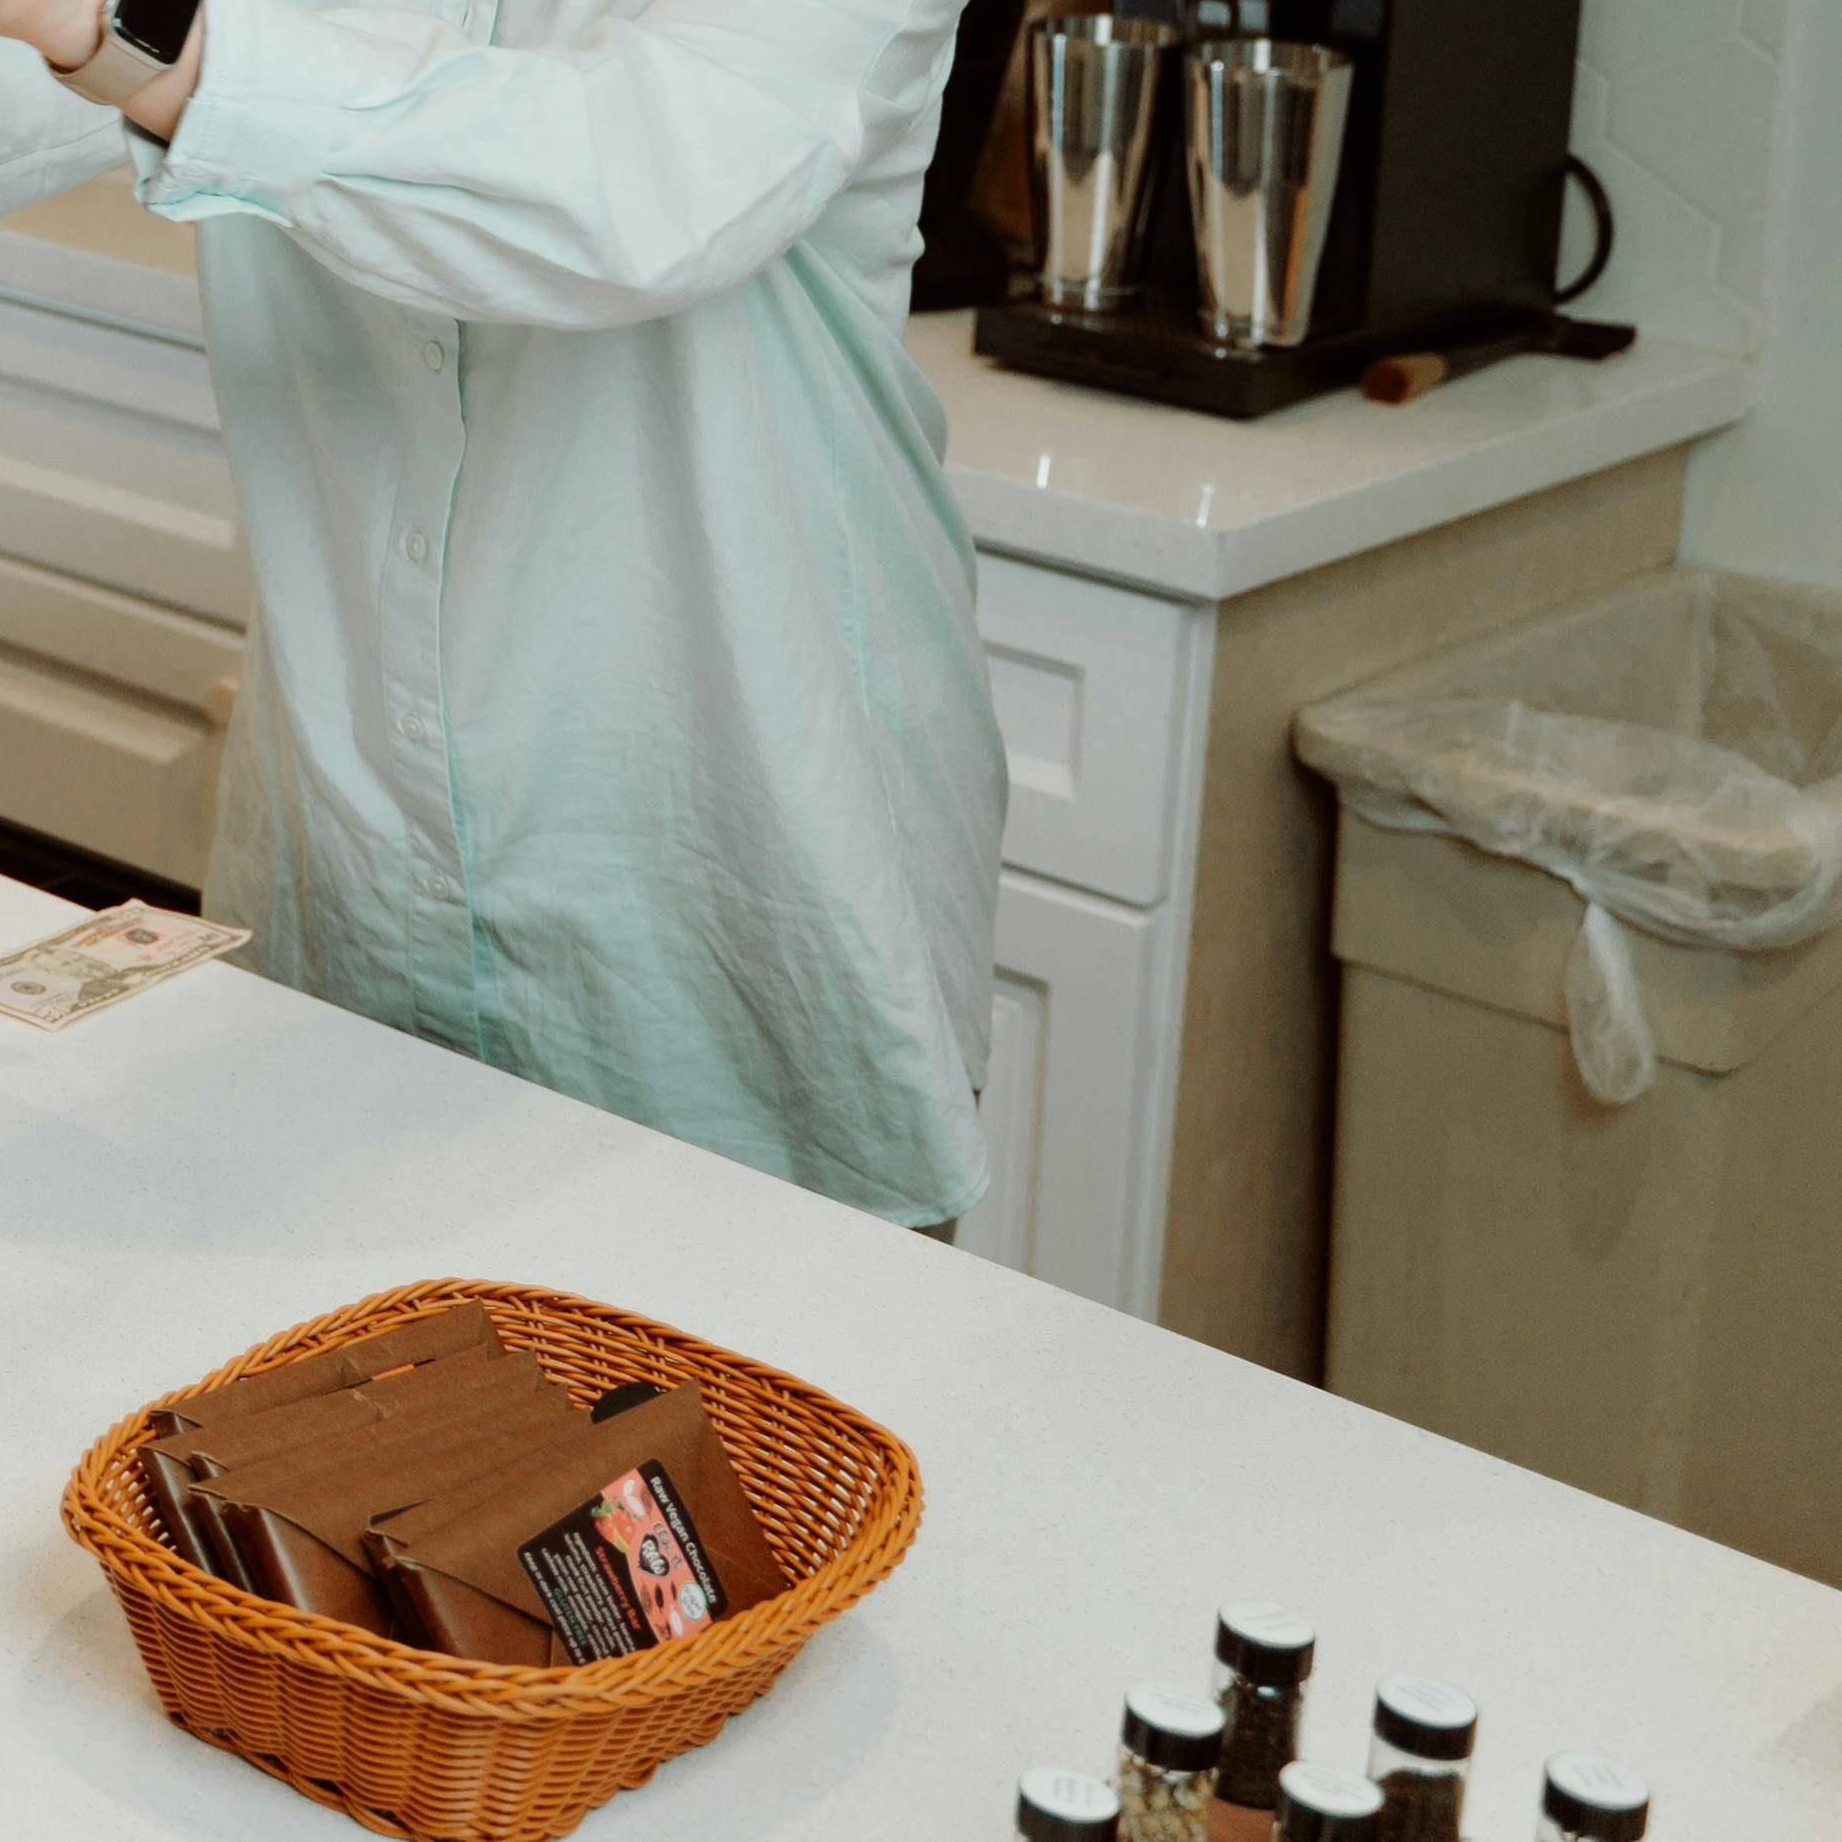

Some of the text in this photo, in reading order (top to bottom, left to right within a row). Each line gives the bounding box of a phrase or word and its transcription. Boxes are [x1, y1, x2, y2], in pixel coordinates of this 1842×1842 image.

[592, 1545, 644, 1633] Strawberry Bar
[649, 1475, 671, 1505] Raw
[663, 1502, 691, 1543] Vegan
[684, 1540, 719, 1605] Chocolate
